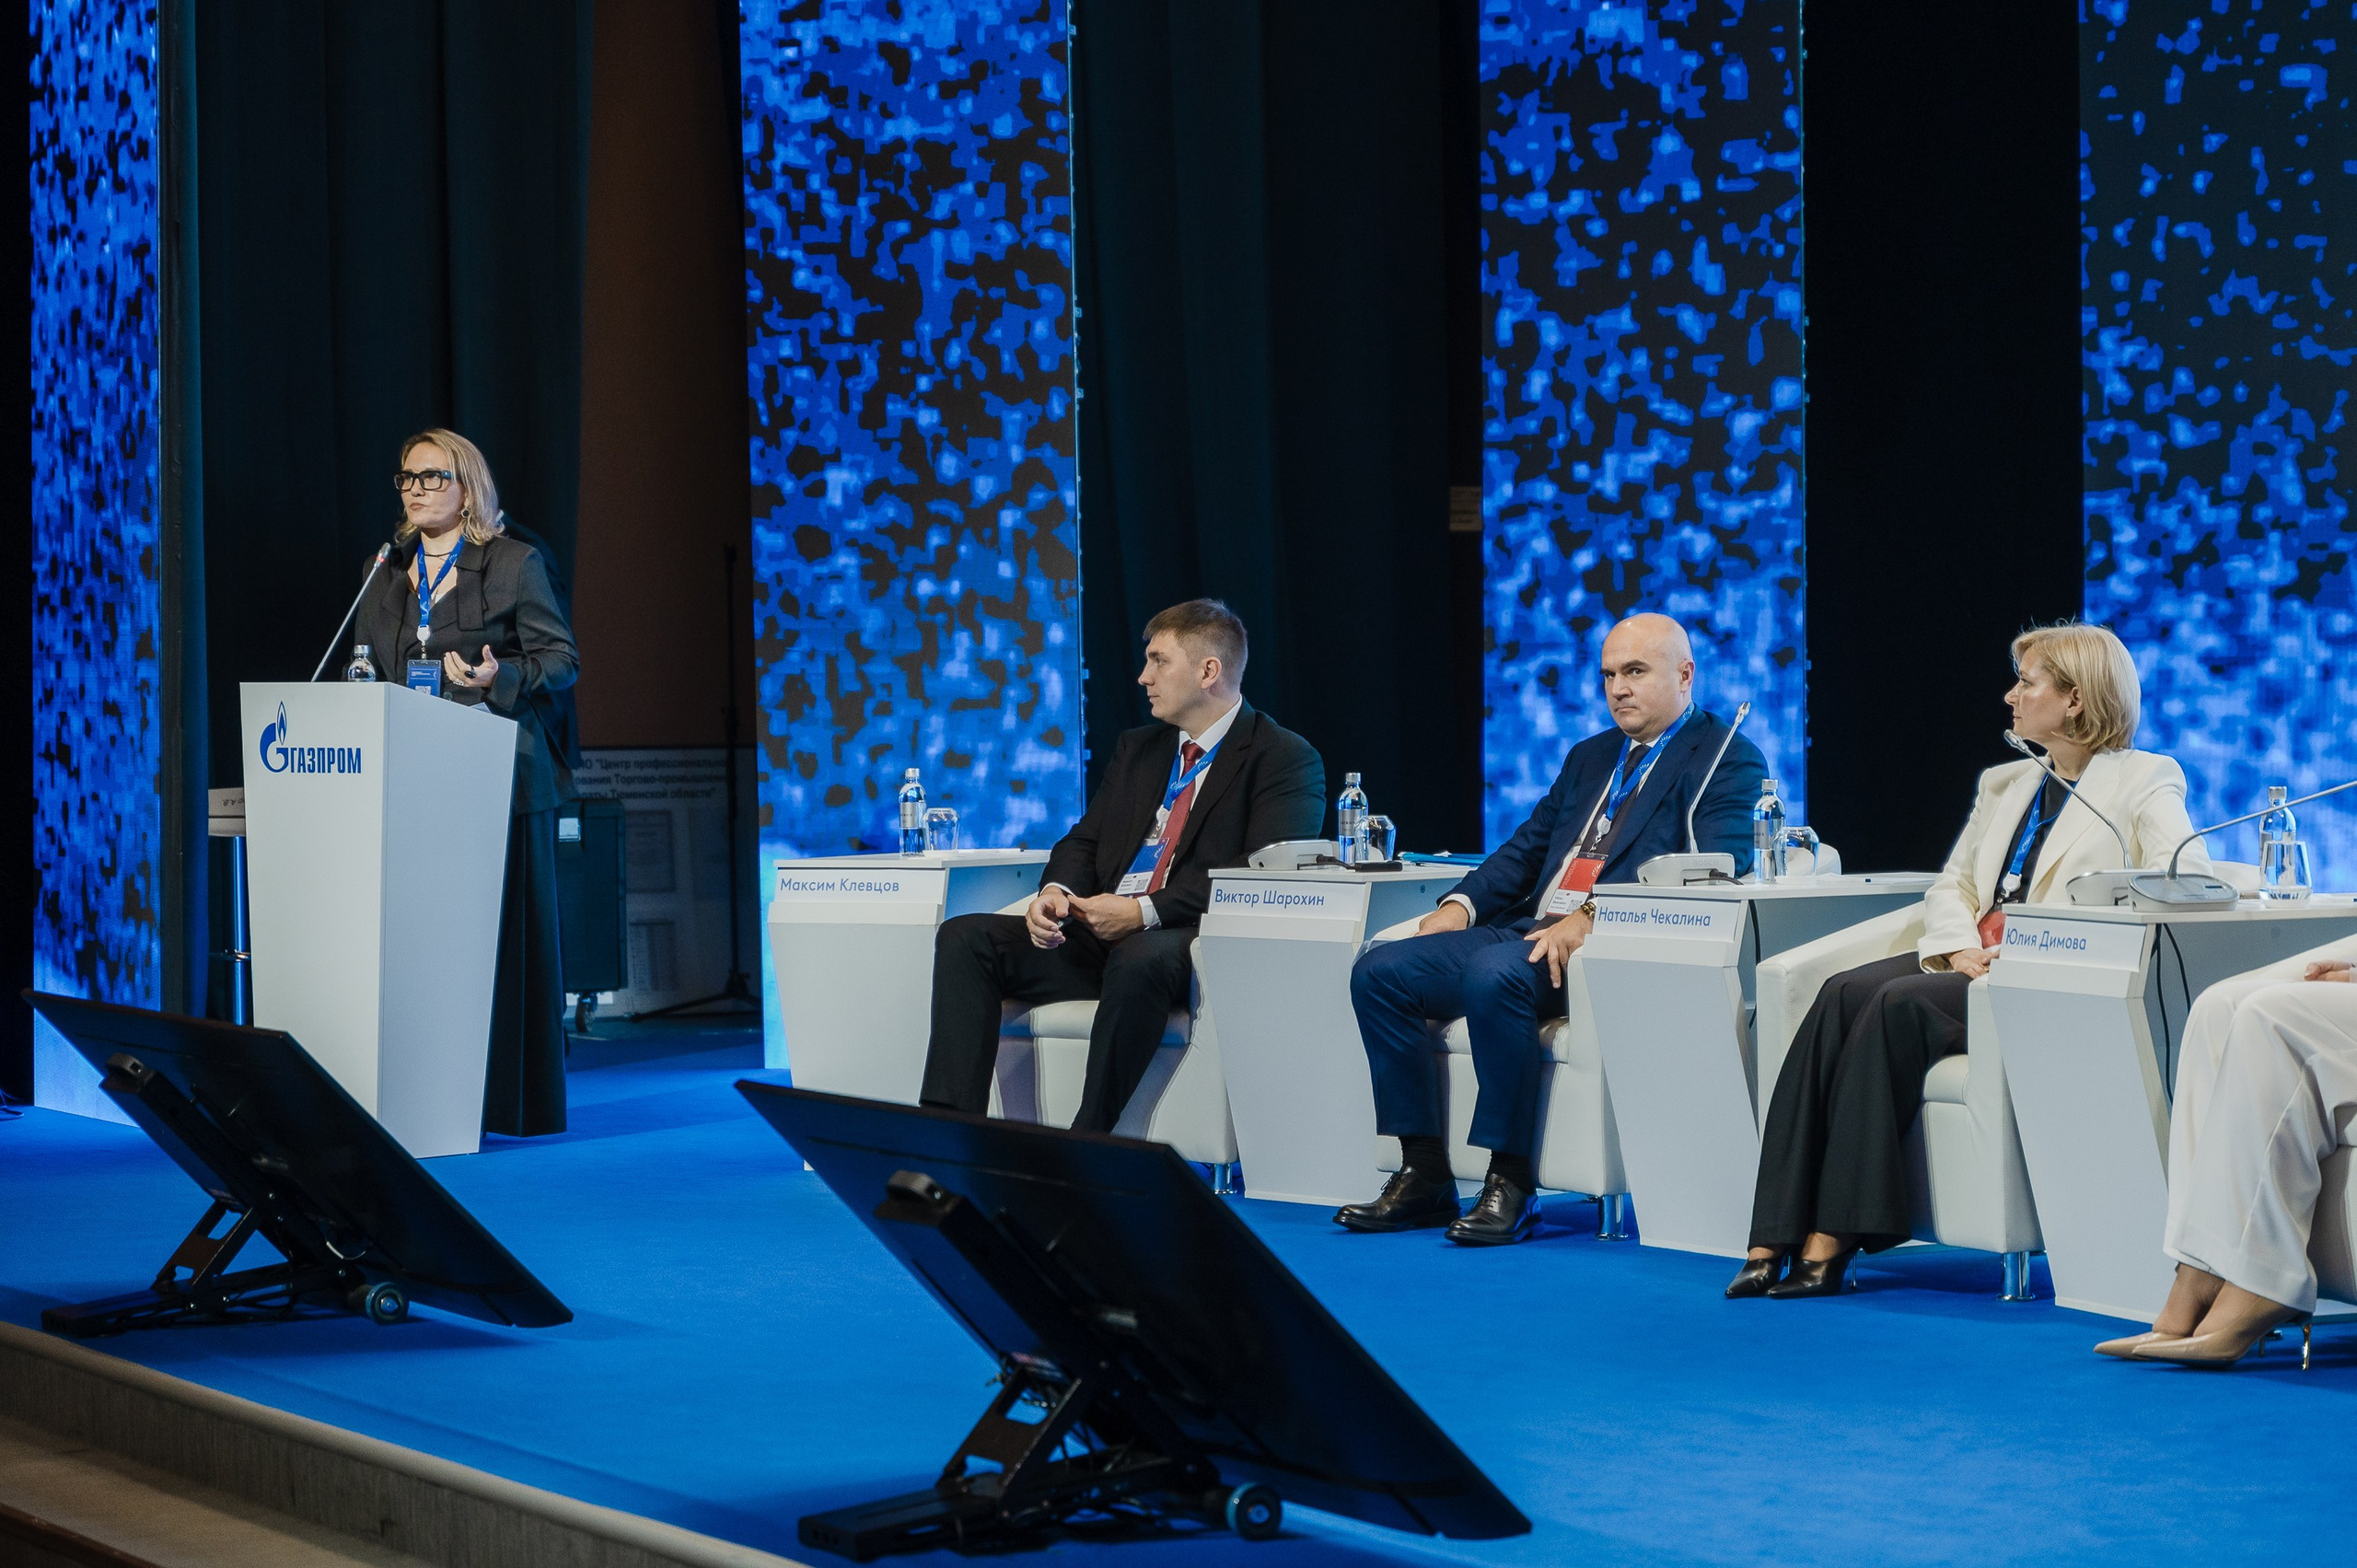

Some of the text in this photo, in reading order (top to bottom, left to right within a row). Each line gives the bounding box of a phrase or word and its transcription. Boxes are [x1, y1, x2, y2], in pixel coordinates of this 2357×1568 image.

[290, 747, 362, 774] ГАЗПРОМ
[633, 758, 727, 772] профессионально
[575, 776, 612, 785] ования
[780, 877, 900, 894] Максим Клевцов
[1214, 889, 1325, 909] Виктор Шарохин
[1598, 906, 1711, 926] Наталья Чекалина
[2005, 927, 2086, 951] Юлия Димова
